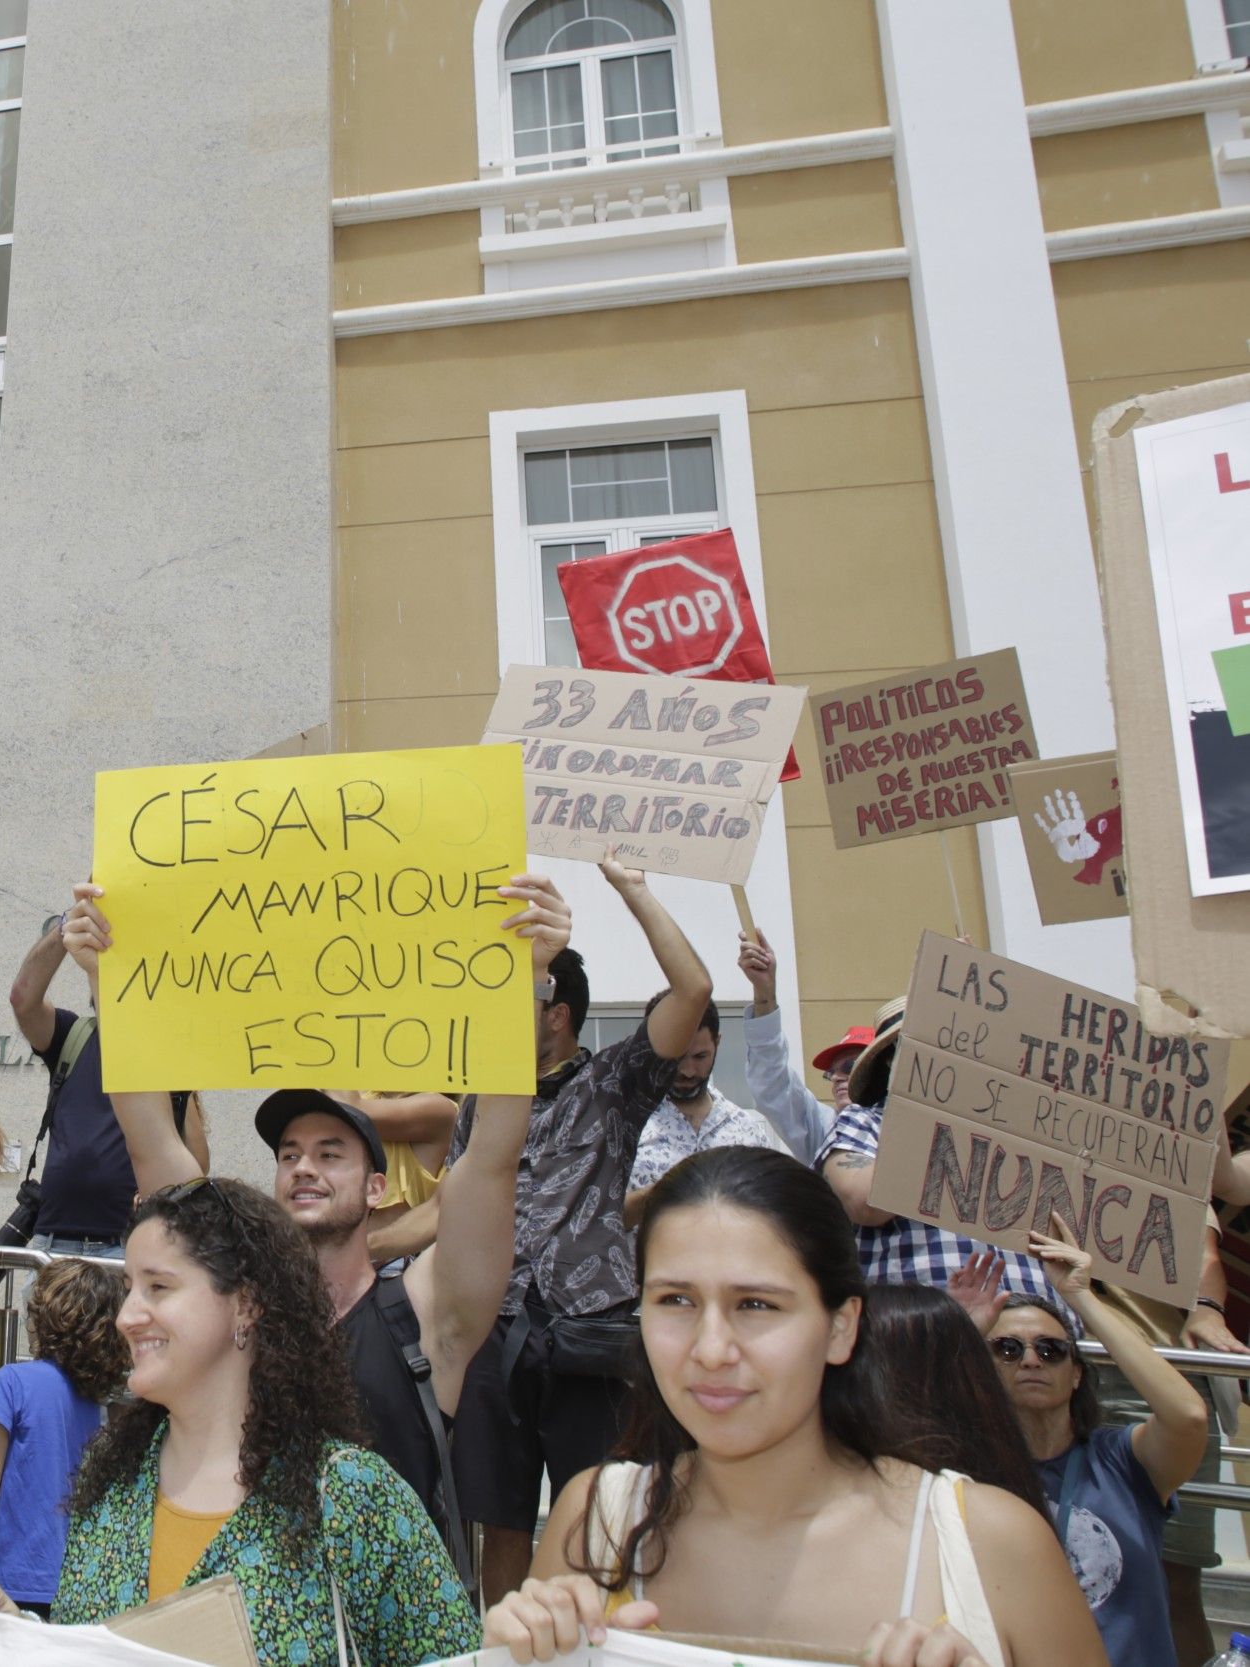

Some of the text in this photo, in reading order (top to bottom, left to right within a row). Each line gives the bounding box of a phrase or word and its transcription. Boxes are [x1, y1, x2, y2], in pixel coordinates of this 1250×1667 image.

[623, 589, 723, 650] STOP
[523, 679, 771, 747] 33 AÑOS
[820, 667, 985, 746] POLÍTICOS
[566, 748, 743, 788] ORDENAR
[877, 739, 1033, 796] DE NUESTRA
[130, 773, 400, 868] CÉSAR
[531, 786, 751, 840] TERRITORIO
[191, 864, 509, 933] MANRIQUE
[117, 935, 514, 1002] NUNCA QUISO
[937, 955, 1009, 1012] LAS
[245, 1011, 470, 1086] ESTO!!
[1019, 1033, 1214, 1134] TERRITORIO
[908, 1052, 1188, 1185] NO SE RECUPERAN
[918, 1120, 1178, 1284] NUNCA
